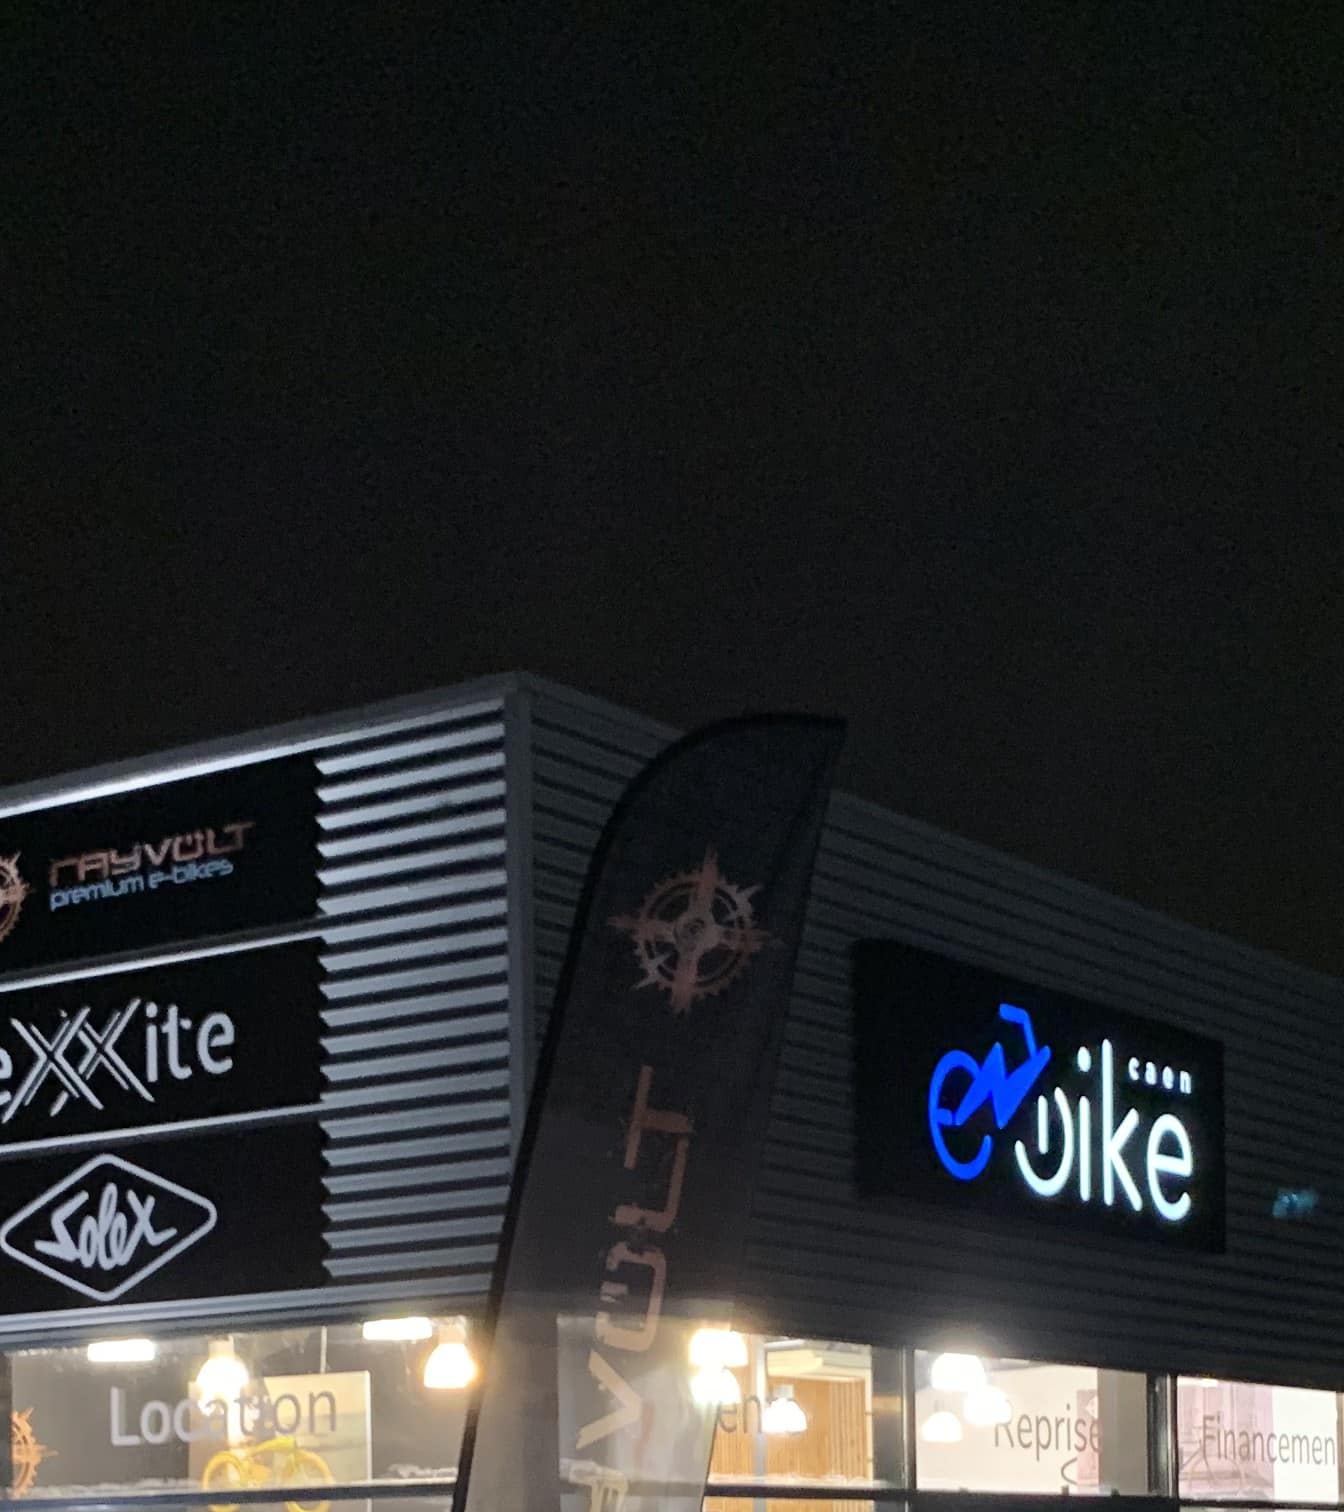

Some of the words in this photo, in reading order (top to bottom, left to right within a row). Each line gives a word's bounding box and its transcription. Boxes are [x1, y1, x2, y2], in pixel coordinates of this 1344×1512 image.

[50, 873, 144, 912] premium
[148, 858, 234, 889] e-bikes
[1128, 1056, 1193, 1095] caen
[994, 1403, 1103, 1463] Reprise
[1203, 1411, 1337, 1465] Financemen
